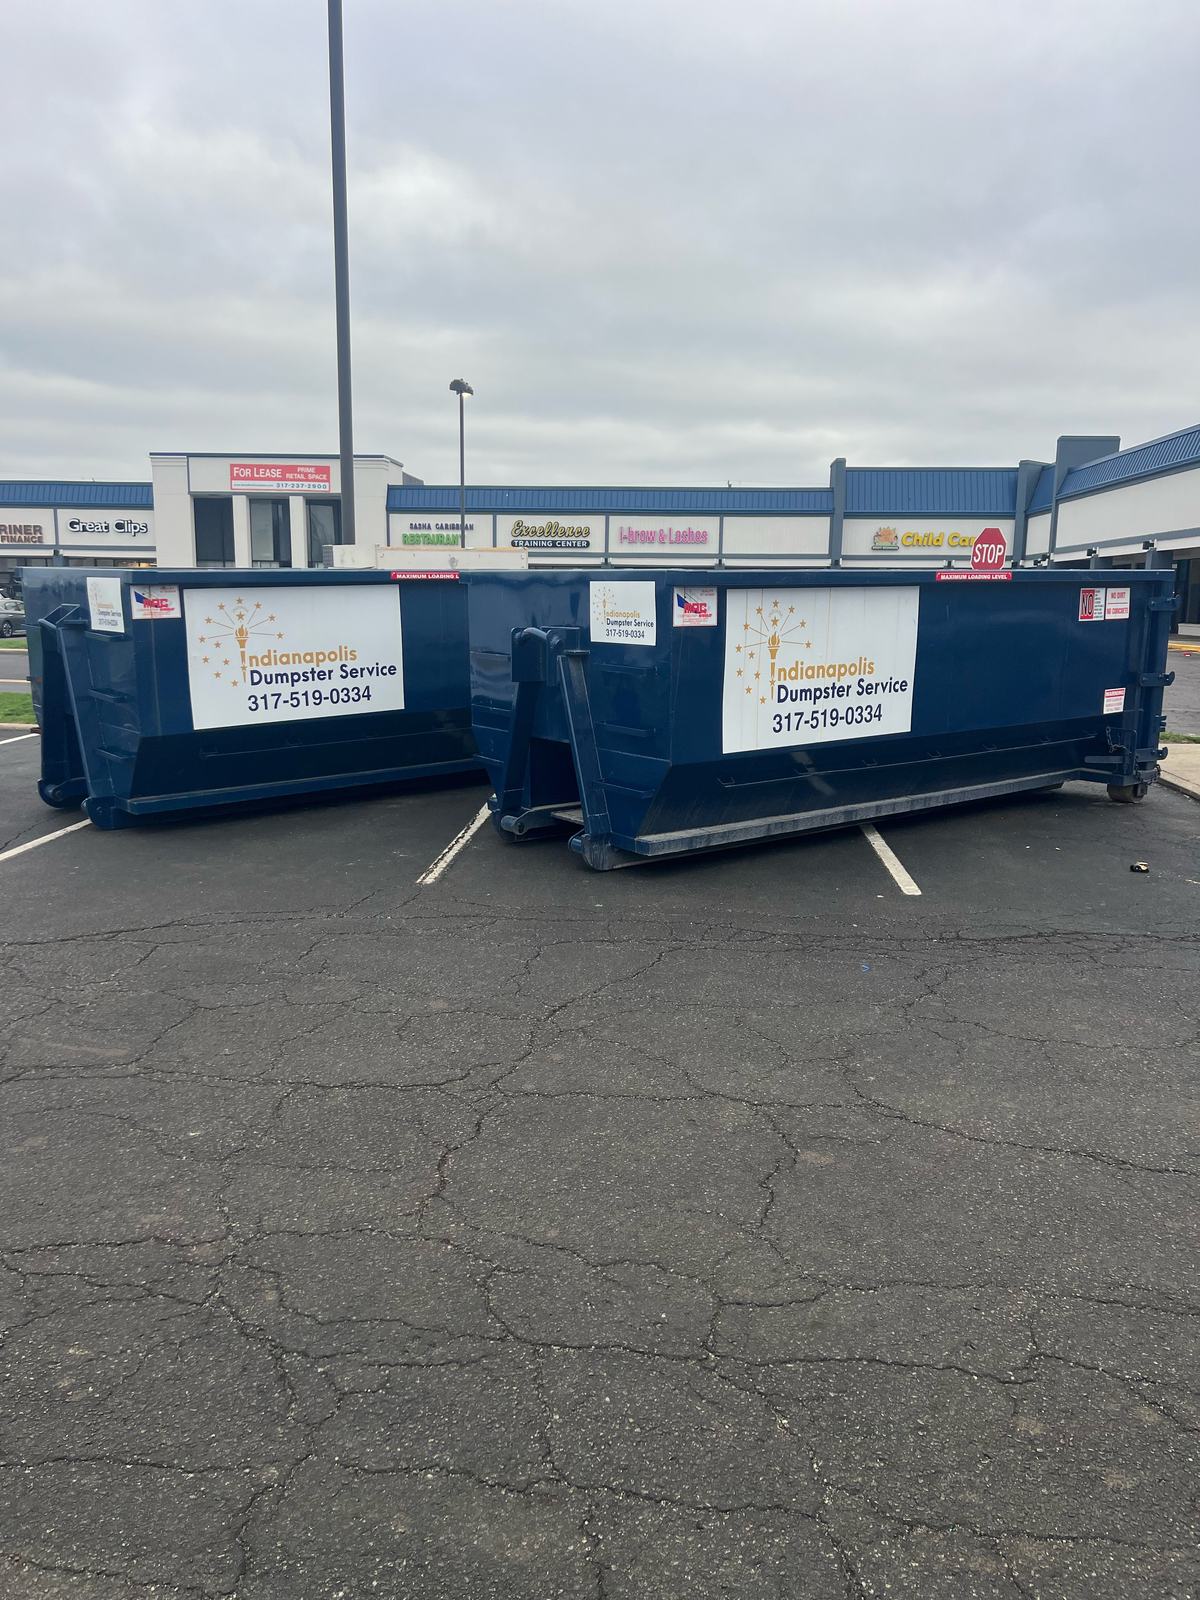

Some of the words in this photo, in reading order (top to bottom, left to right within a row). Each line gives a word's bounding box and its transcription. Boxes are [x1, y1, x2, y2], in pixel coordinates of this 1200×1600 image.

[233, 467, 251, 477] FOR
[254, 467, 282, 478] LEASE
[0, 524, 43, 535] RINER
[67, 518, 109, 533] Great
[114, 519, 148, 537] Clips
[435, 523, 474, 531] CARIBBAN
[511, 520, 590, 538] Excellence
[658, 528, 665, 544] &
[669, 527, 708, 544] Lashes
[1, 535, 44, 544] FINANCE
[402, 533, 464, 546] RESTAURAN
[901, 531, 944, 547] Child
[947, 532, 976, 547] Car
[973, 544, 1004, 564] STOP
[1080, 592, 1095, 616] NO
[606, 618, 632, 627] Dumpster
[634, 618, 654, 628] Service
[606, 628, 645, 638] 317-519-0334
[250, 668, 334, 687] Dumpster
[339, 662, 398, 680] Service
[248, 685, 372, 712] 317-519-0334
[777, 682, 852, 705] Dumpster
[856, 676, 909, 696] Service
[772, 703, 883, 734] 317-519-0334
